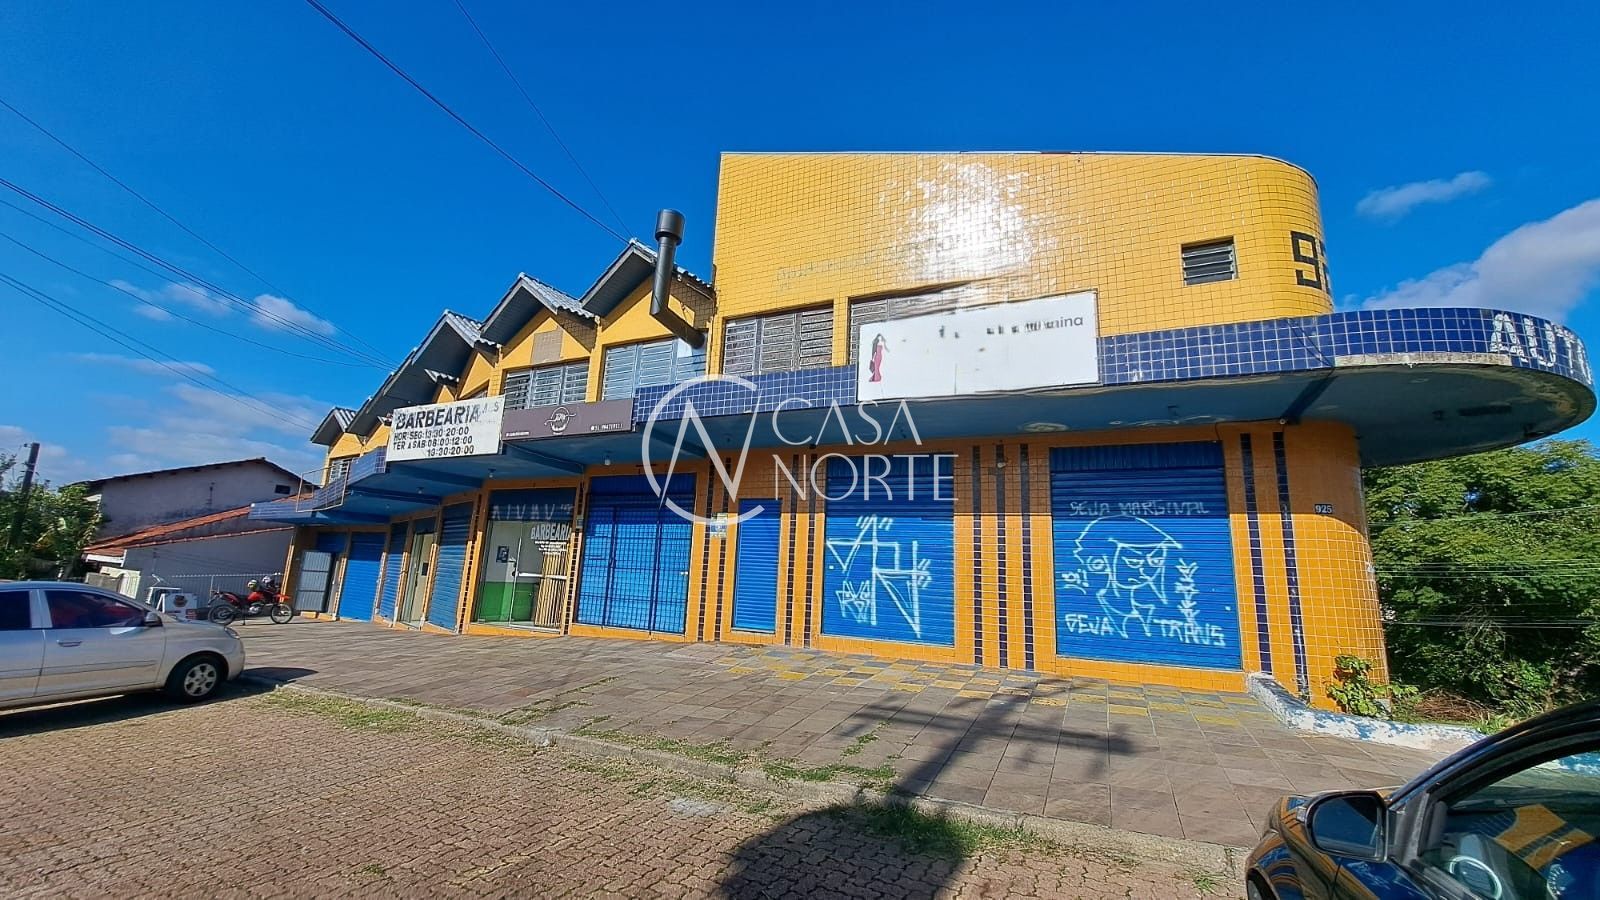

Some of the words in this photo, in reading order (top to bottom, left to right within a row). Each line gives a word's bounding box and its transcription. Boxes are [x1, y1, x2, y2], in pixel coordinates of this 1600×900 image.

[1291, 231, 1331, 296] 9
[396, 405, 479, 430] BARBEARIA
[393, 441, 406, 451] TER
[1315, 505, 1333, 514] 925
